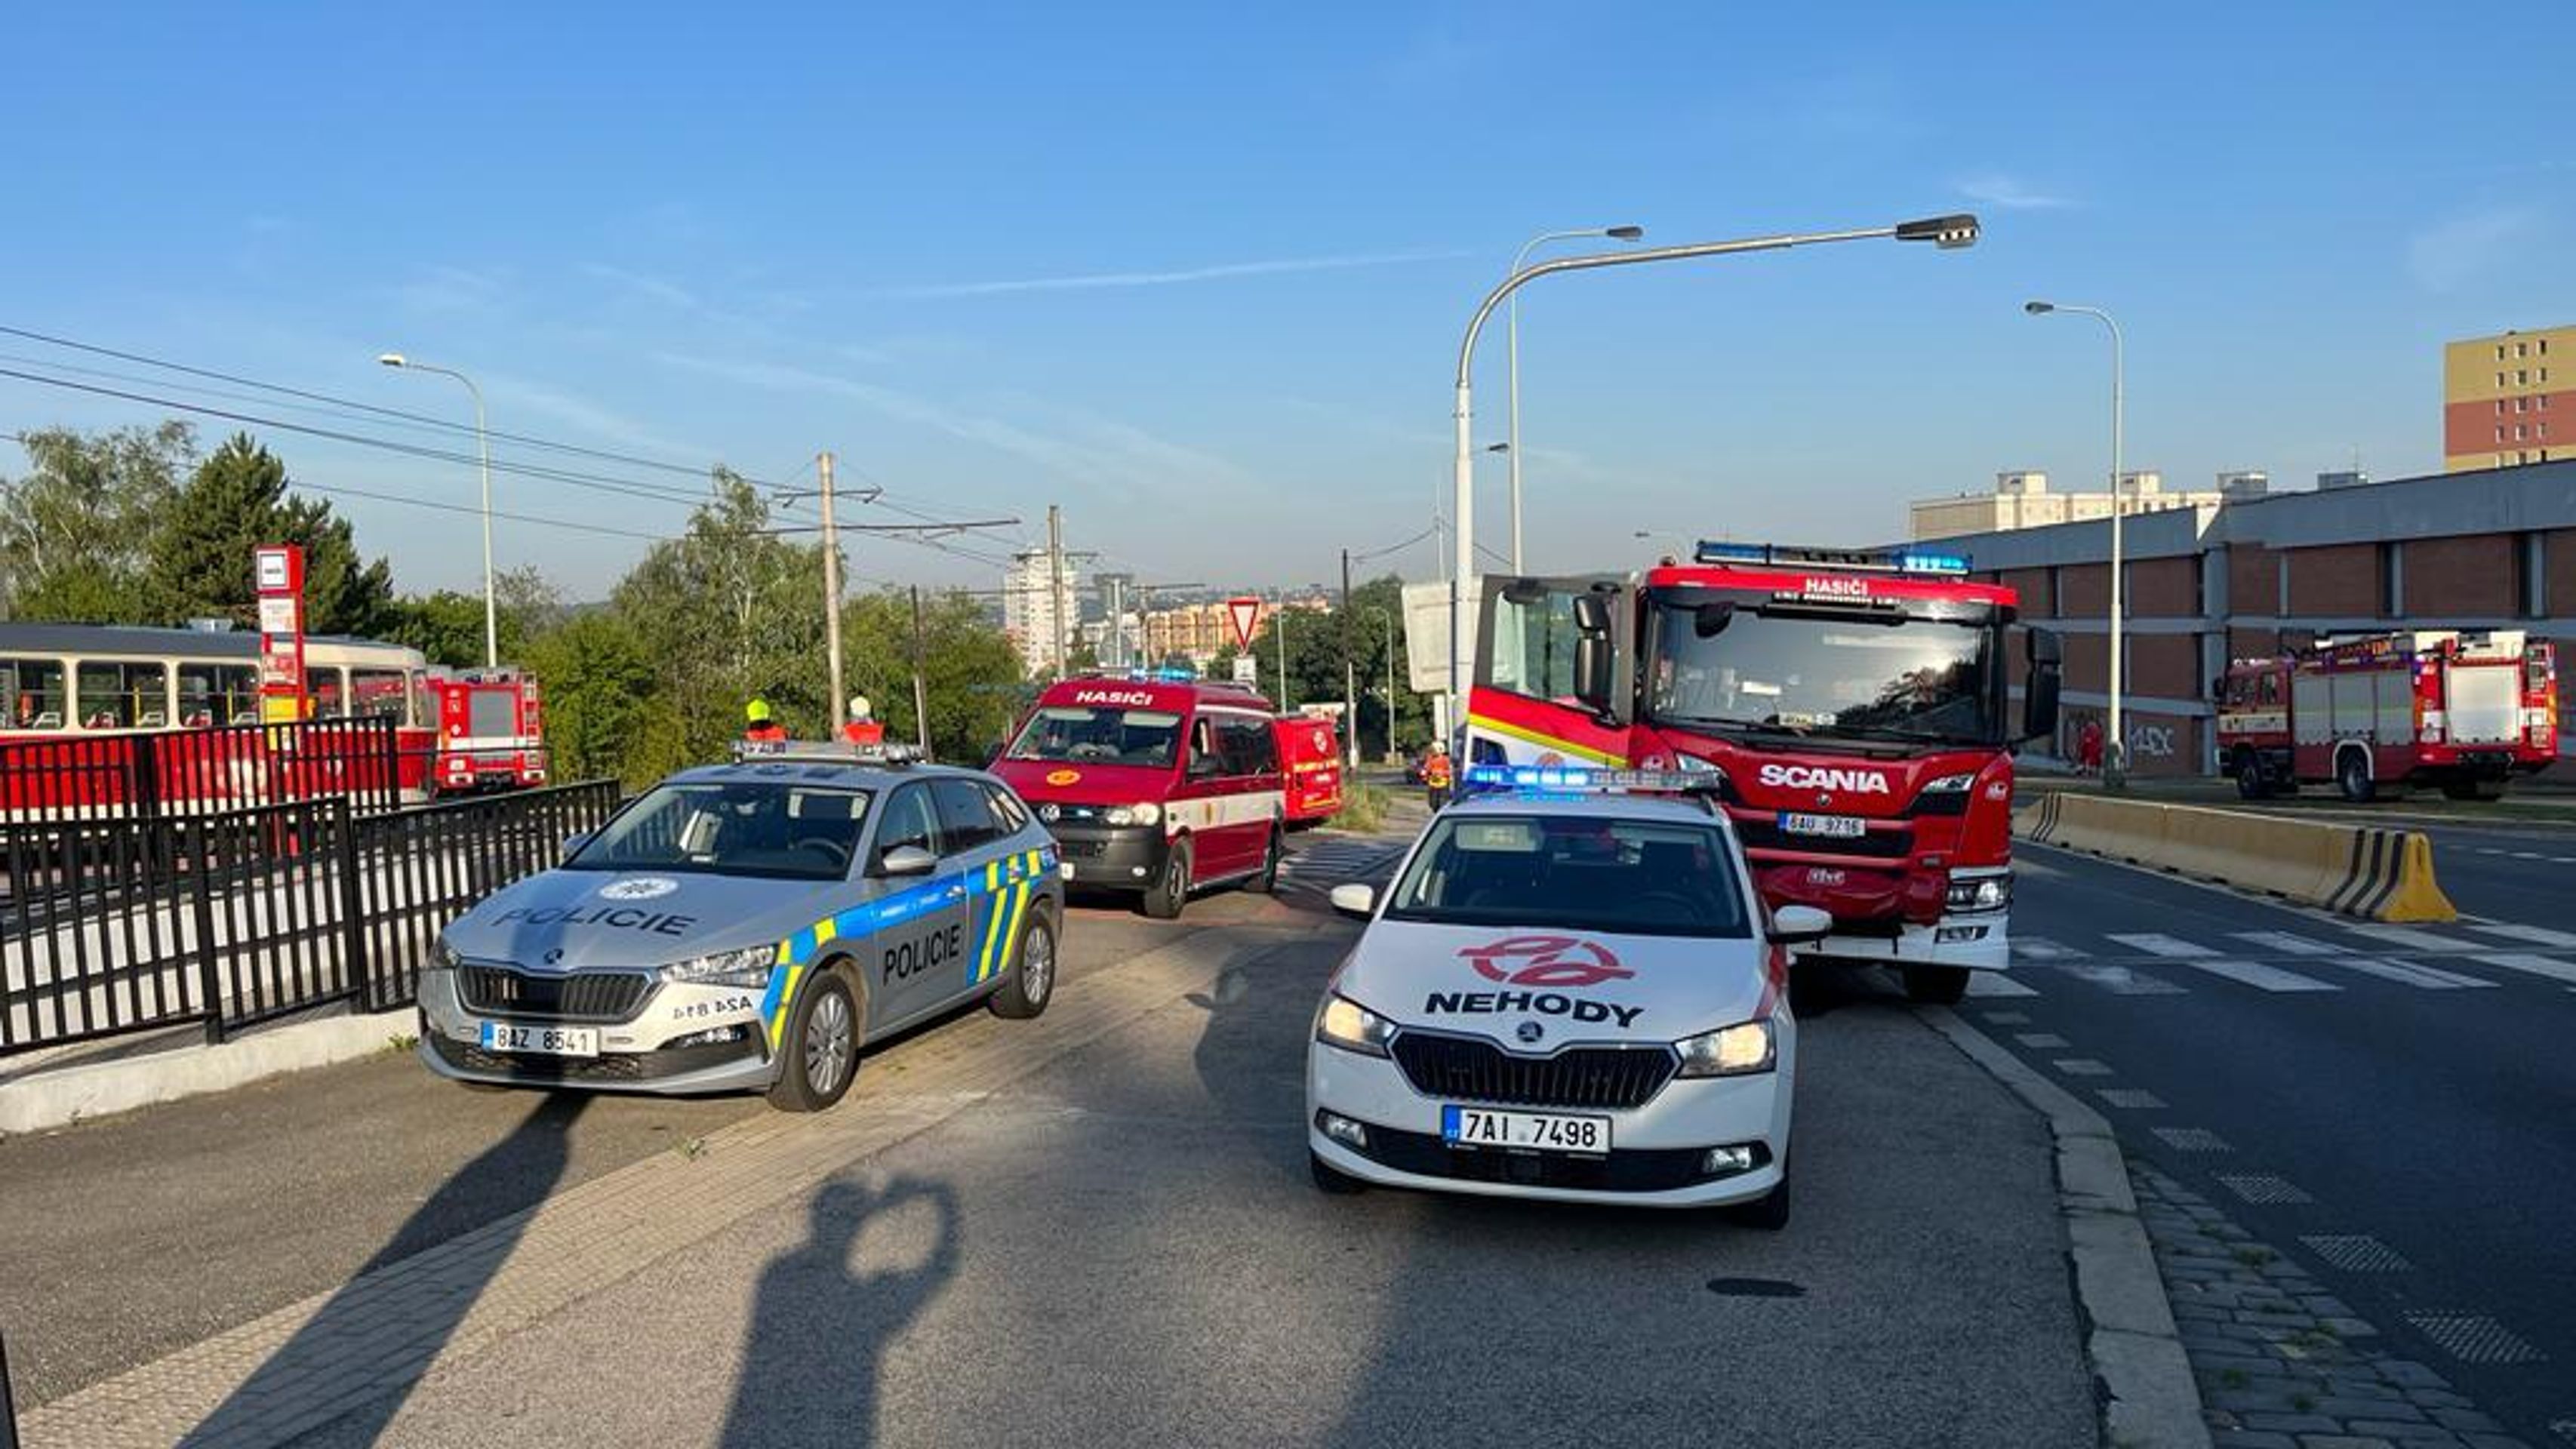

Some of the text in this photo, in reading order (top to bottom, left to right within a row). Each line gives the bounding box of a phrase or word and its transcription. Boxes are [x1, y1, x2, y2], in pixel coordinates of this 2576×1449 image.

[1805, 578, 1869, 595] HASIČI
[1759, 764, 1890, 794] SCANIA
[491, 907, 698, 937] POLICIE
[883, 924, 962, 986] POLICIE
[1425, 990, 1644, 1028] NEHODY
[497, 1026, 589, 1053] 8AZ 8541
[1467, 1112, 1597, 1147] 7AI 7498
